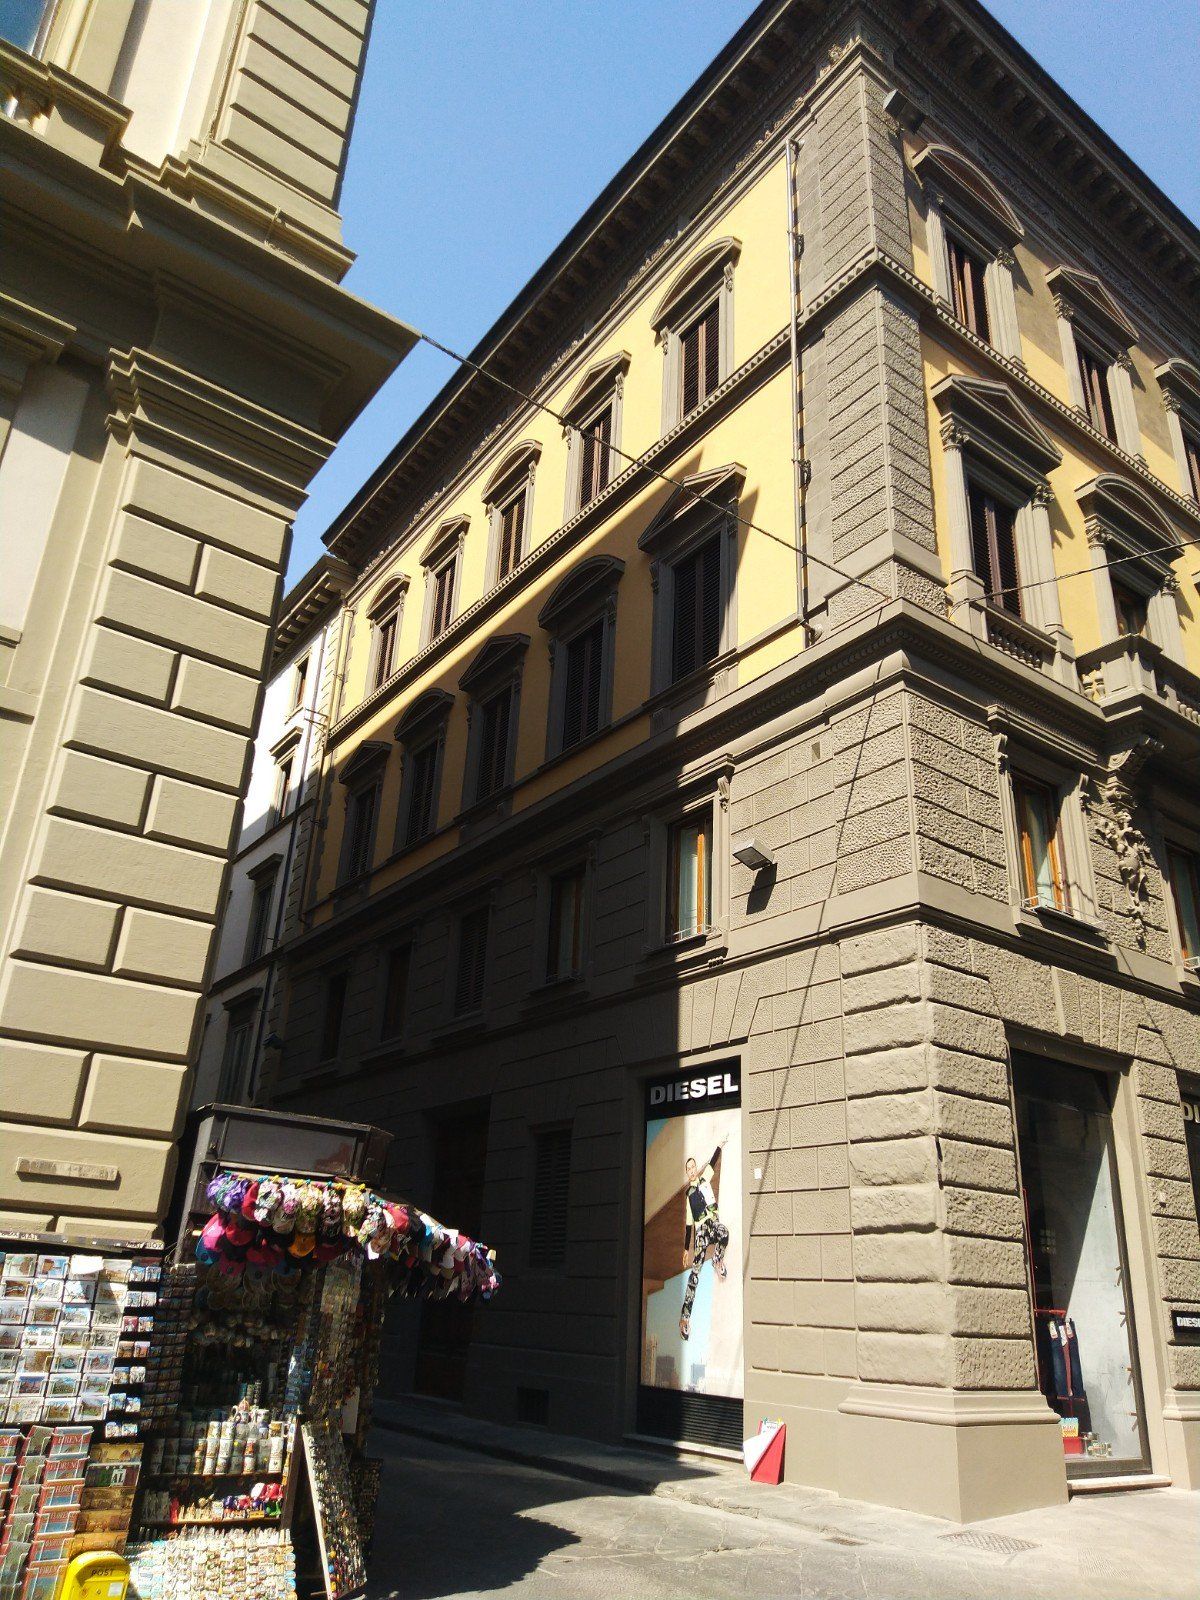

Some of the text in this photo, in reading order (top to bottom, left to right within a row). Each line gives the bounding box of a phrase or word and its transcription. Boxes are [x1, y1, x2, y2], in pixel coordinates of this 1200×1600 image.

[650, 1073, 739, 1105] DIESEL
[1176, 1316, 1200, 1328] DIES
[91, 1569, 114, 1577] POST
